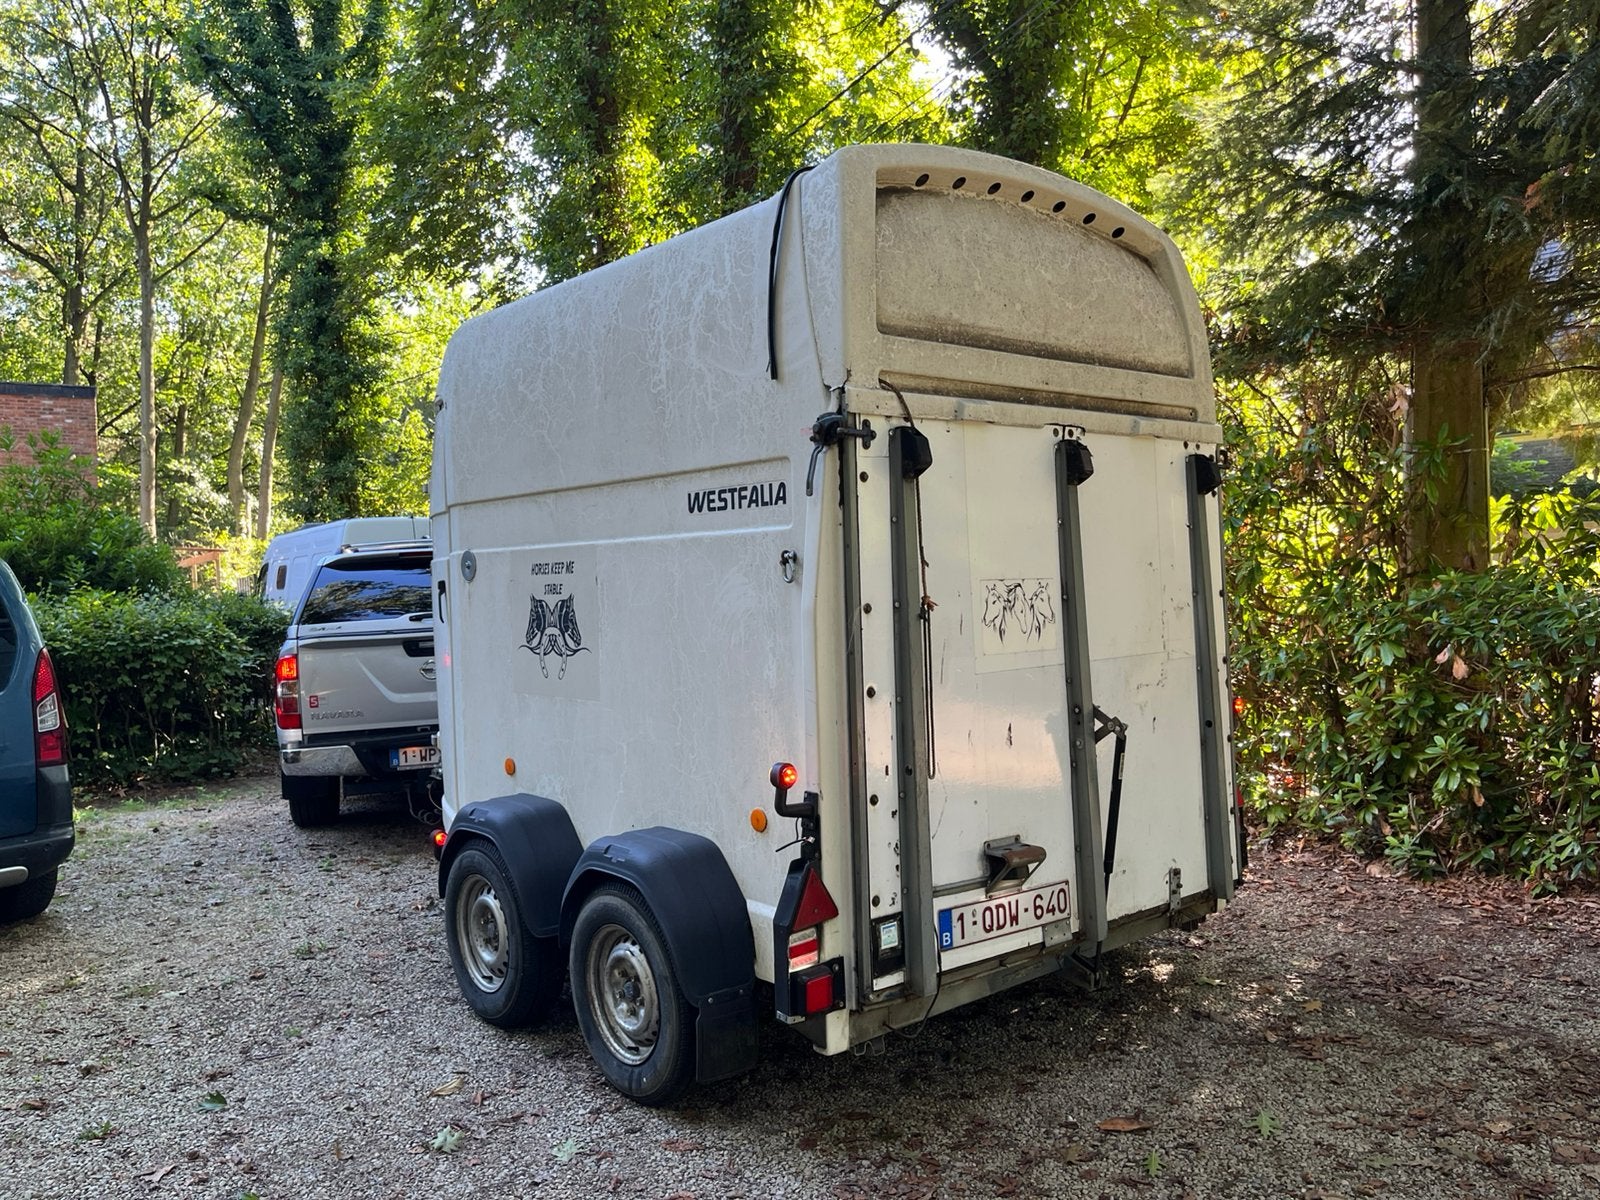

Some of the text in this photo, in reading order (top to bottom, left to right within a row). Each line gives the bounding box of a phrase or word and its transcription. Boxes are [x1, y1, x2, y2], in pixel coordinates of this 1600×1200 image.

[687, 482, 787, 514] WESTFALIA
[530, 560, 575, 576] HORSES KEEP ME
[543, 583, 564, 596] STABLE
[942, 887, 1068, 946] B 1-QDW-640
